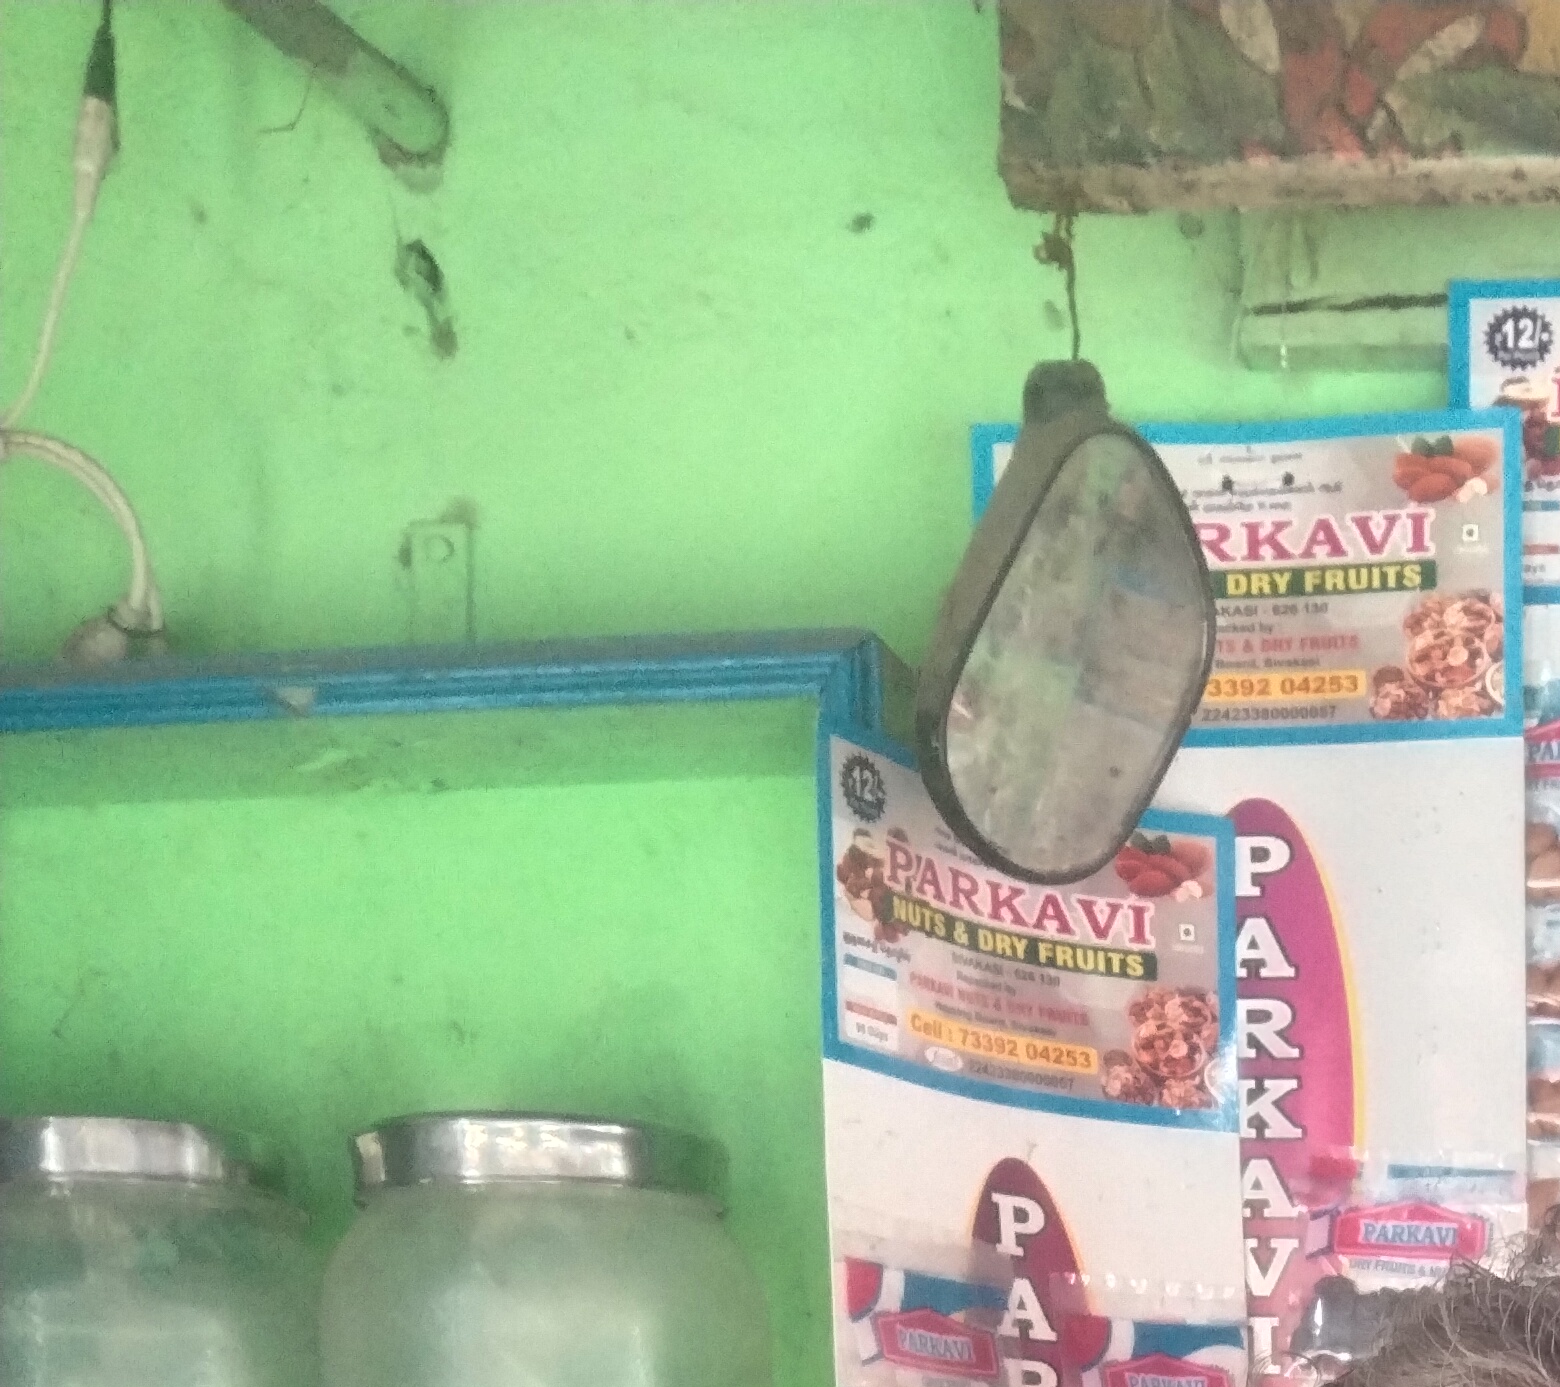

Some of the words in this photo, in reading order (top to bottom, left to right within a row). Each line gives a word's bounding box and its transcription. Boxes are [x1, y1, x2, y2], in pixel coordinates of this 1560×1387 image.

[1194, 511, 1430, 563] RKAVI
[1226, 571, 1293, 596] DRY
[1303, 563, 1422, 594] FRUITS
[1207, 677, 1273, 698] 3392
[1279, 674, 1359, 696] 04253
[886, 839, 1153, 946] PARKAVI
[893, 895, 946, 938] NUTS
[953, 920, 969, 946] &
[978, 928, 1028, 960] DRY
[1038, 941, 1145, 978] FRUITS
[910, 1012, 943, 1039] Cell
[959, 1027, 1019, 1058] 73392
[1025, 1042, 1092, 1069] 04253
[1363, 1221, 1458, 1246] PARKAVI
[901, 1331, 973, 1362] PARKAVI
